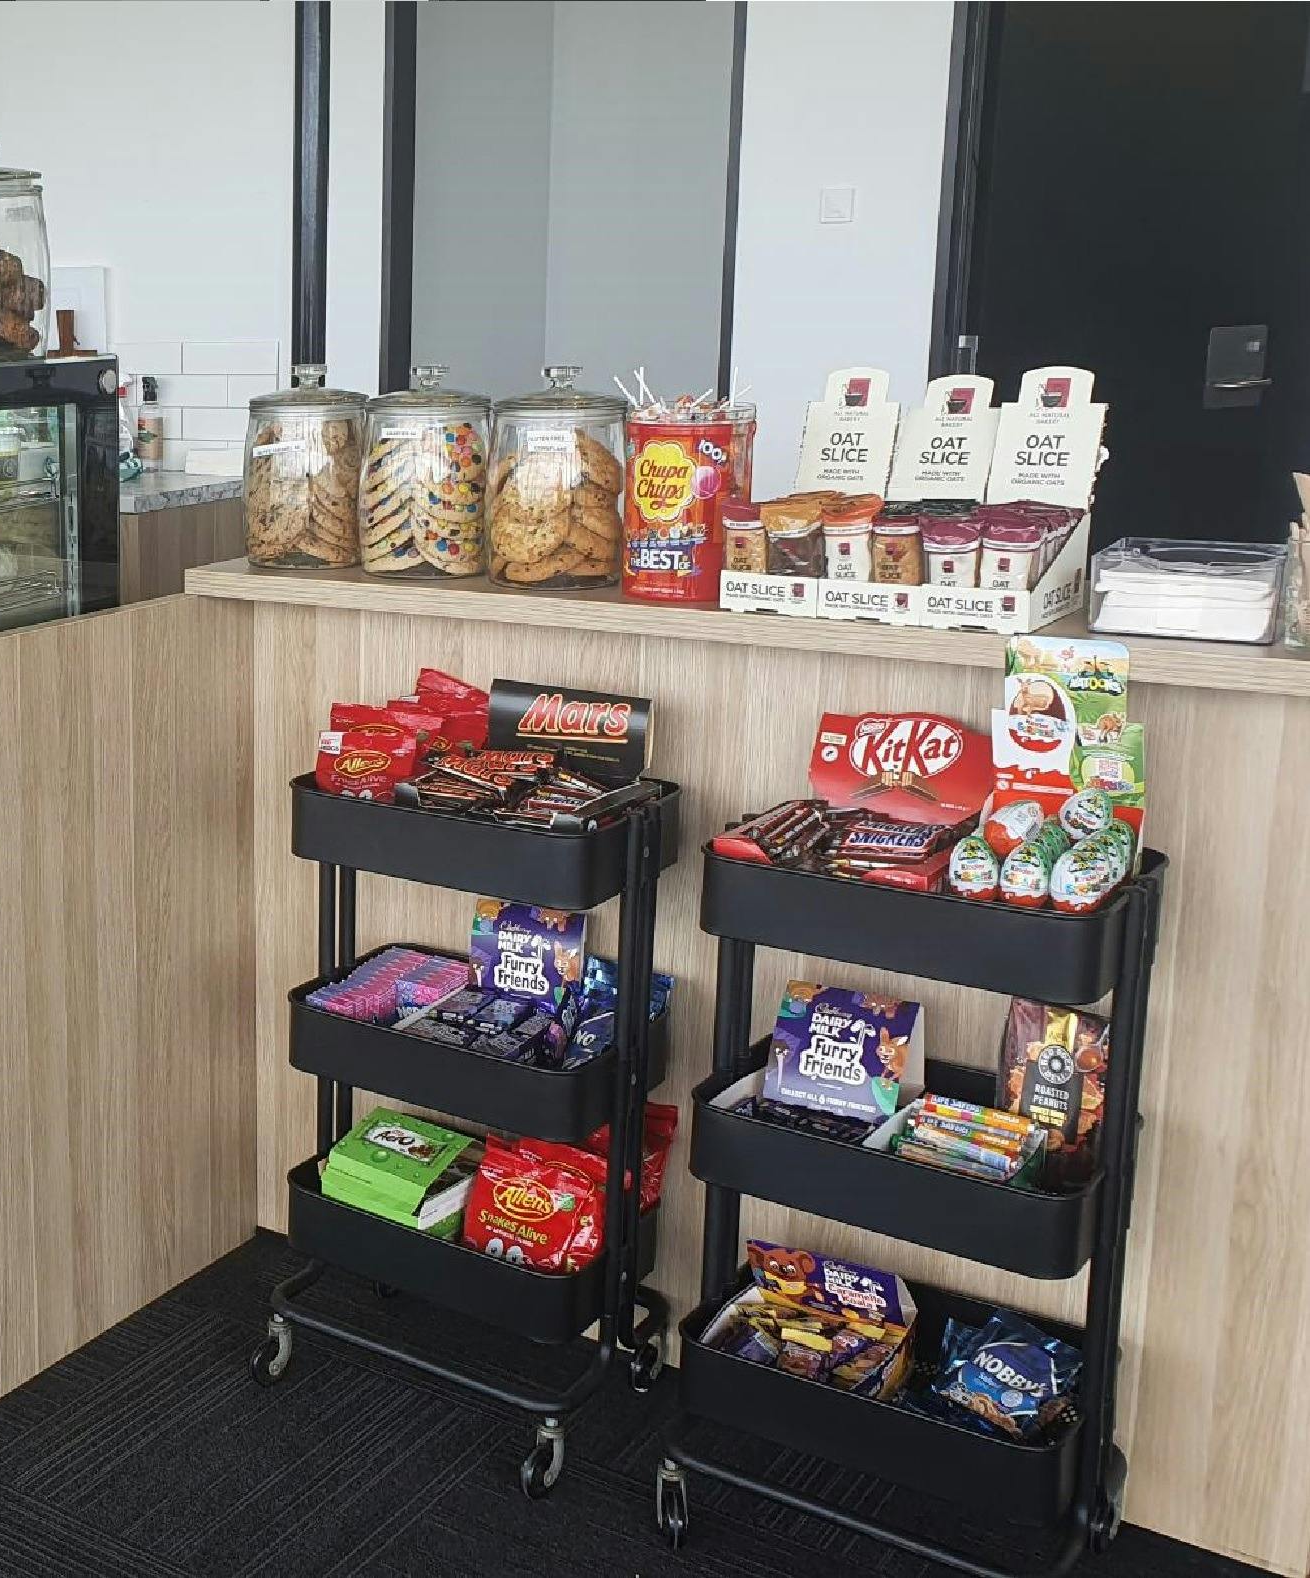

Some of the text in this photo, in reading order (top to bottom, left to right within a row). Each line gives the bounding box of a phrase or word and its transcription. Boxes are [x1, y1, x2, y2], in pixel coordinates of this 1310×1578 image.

[829, 432, 865, 446] OAT
[930, 436, 968, 450] OAT
[1026, 434, 1066, 450] OAT
[820, 447, 868, 463] SLICE
[919, 451, 971, 466] SLICE
[1014, 451, 1071, 467] SLICE
[640, 459, 689, 484] Chupa
[636, 480, 685, 500] Chups
[640, 548, 682, 570] BEST
[837, 564, 853, 572] OAT
[726, 581, 749, 593] OAT
[751, 583, 786, 598] SLICE
[992, 579, 1011, 587] OAT
[825, 590, 889, 607] OAT SLICE
[927, 596, 994, 613] OAT SLICE
[517, 692, 631, 737] Mars
[861, 720, 958, 776] KitKat
[848, 831, 927, 848] SNICKERS
[498, 930, 532, 944] DAIRY
[498, 940, 524, 954] MILK
[504, 954, 541, 975] Furry
[497, 969, 546, 992] Friends
[811, 1013, 852, 1029] DAIRY
[809, 1023, 841, 1038] MILK
[814, 1038, 859, 1063] Furry
[803, 1054, 862, 1082] Friends
[1034, 1083, 1070, 1100] ROASTED
[1033, 1094, 1068, 1111] PEANUTS
[478, 1208, 519, 1233] Snakes
[517, 1224, 548, 1245] Alive
